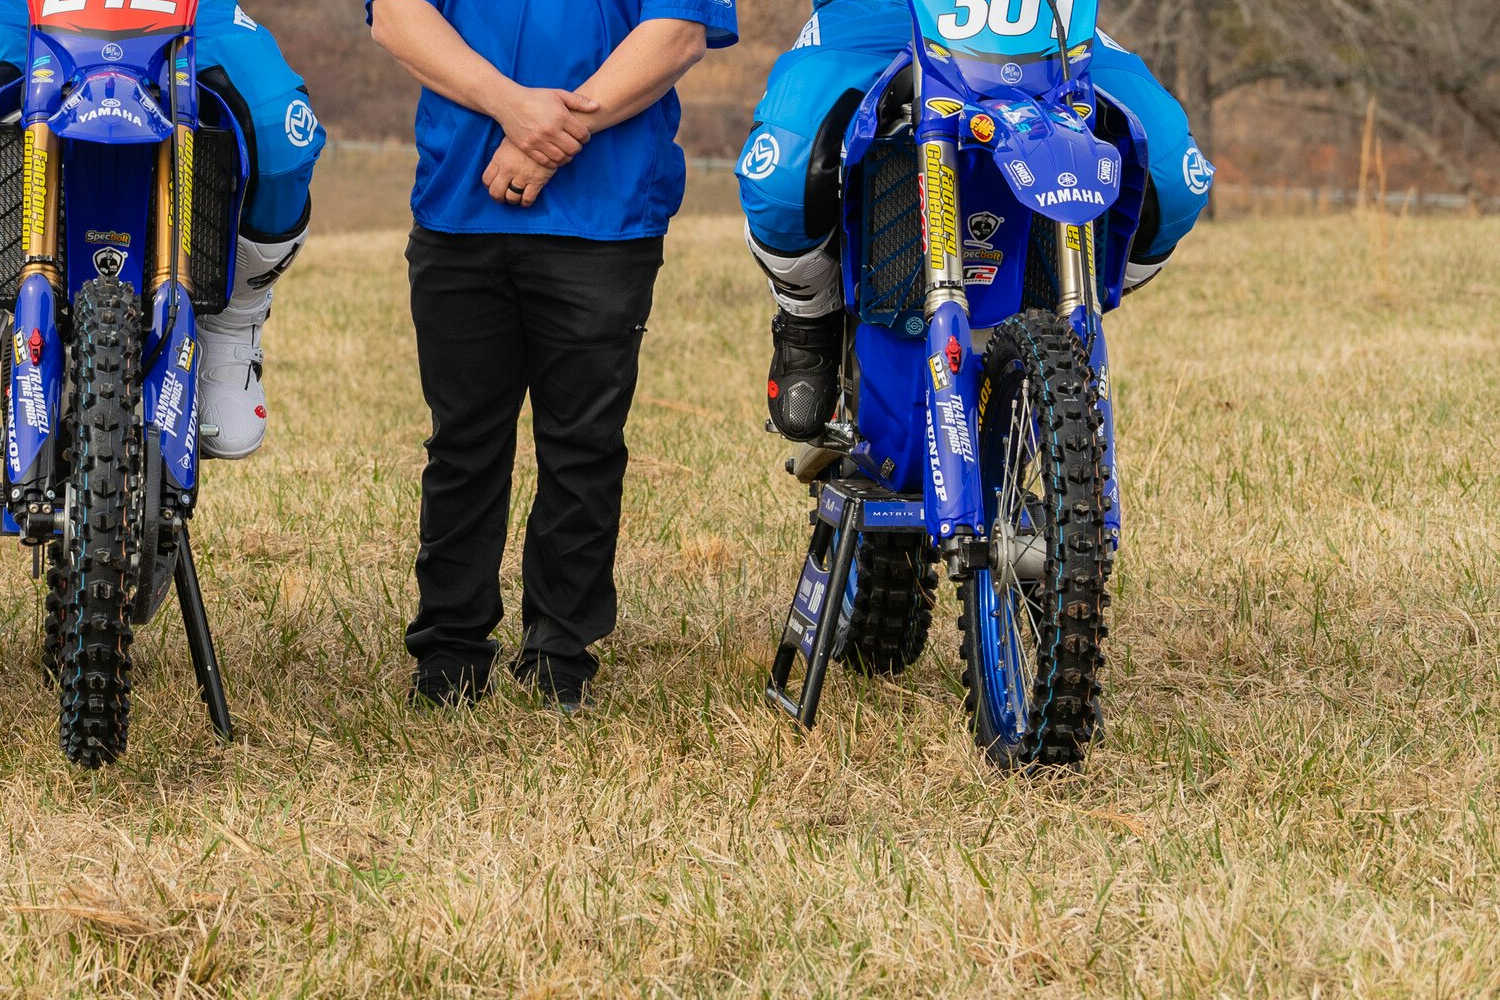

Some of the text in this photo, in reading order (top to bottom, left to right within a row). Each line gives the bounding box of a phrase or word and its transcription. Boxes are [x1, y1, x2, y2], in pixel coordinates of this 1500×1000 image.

[78, 107, 142, 127] YAMAHA
[970, 118, 995, 138] FMF
[1014, 161, 1030, 185] SHOEI
[1099, 160, 1111, 182] SHOEI
[1035, 188, 1105, 207] YAMAHA
[86, 231, 130, 245] Specbolt
[16, 374, 37, 427] TIRE PROS
[29, 367, 49, 434] TRAMMELL
[163, 380, 183, 437] TIRE PROS
[936, 401, 962, 456] TIRE PROS
[949, 393, 974, 463] TRAMMELL
[926, 407, 948, 502] DUNLOP
